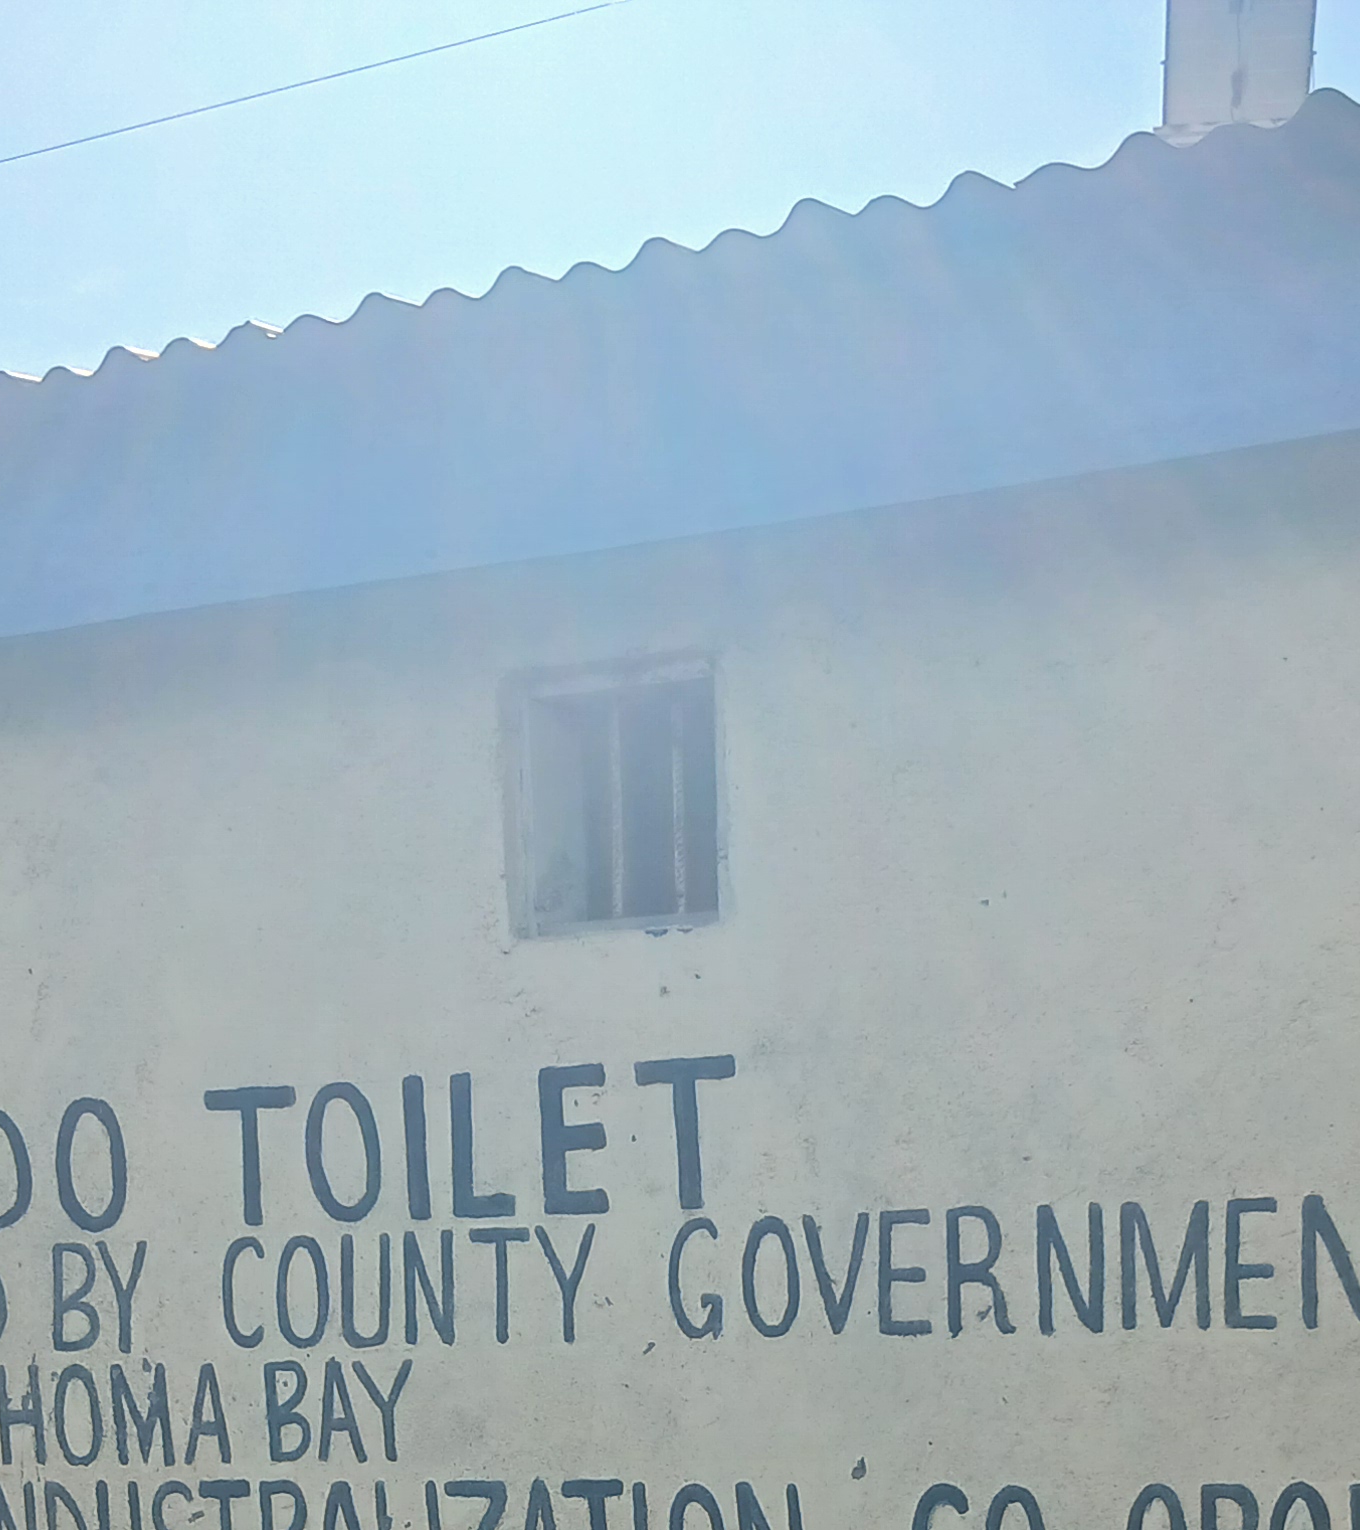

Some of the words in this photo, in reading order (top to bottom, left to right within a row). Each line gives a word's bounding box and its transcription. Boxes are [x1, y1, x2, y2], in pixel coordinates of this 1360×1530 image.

[203, 1054, 737, 1228] TOILET
[51, 1240, 148, 1355] BY
[221, 1223, 597, 1350] COUNTY
[262, 1357, 414, 1464] BAY
